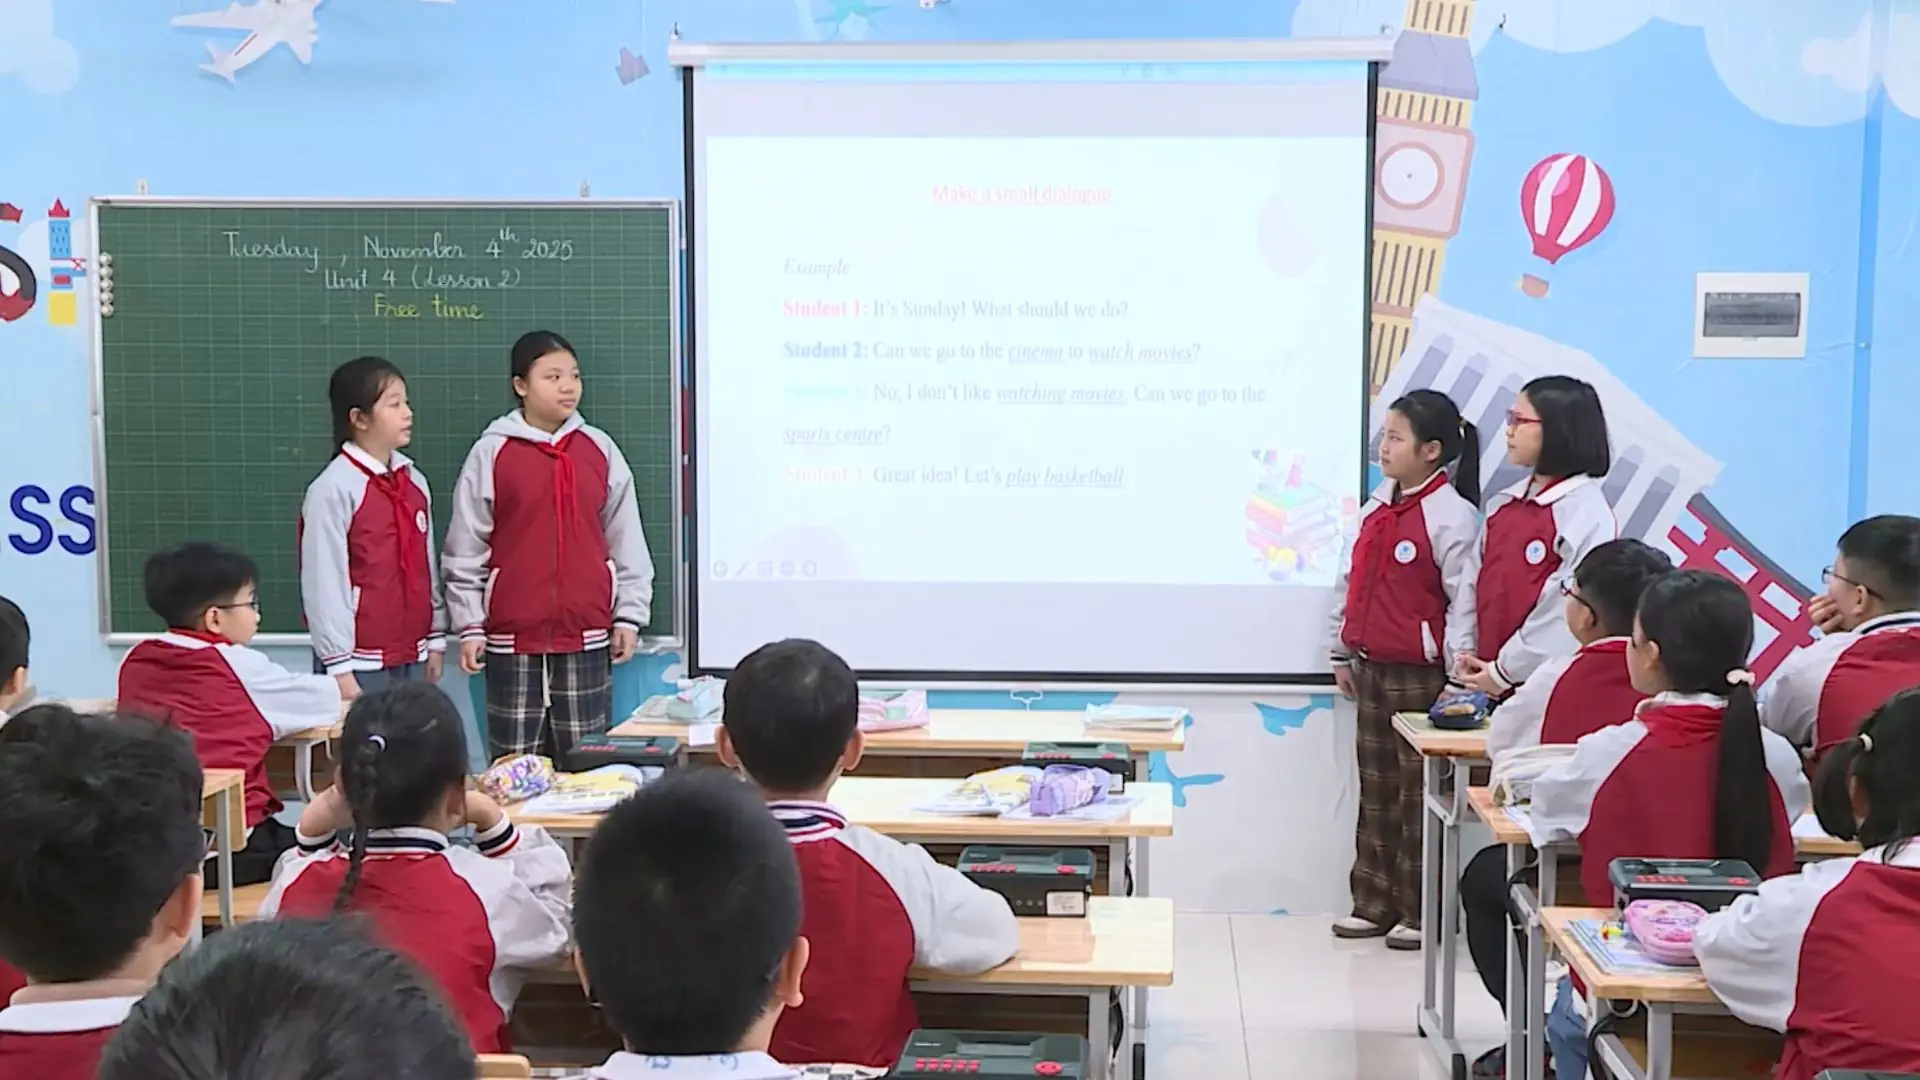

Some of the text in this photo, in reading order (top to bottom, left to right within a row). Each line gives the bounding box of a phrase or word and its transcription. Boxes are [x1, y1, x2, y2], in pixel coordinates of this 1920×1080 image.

[932, 184, 1111, 206] Make a small dialogue
[222, 231, 319, 273] Tuesday
[363, 231, 464, 259] November
[521, 238, 573, 261] 2025
[324, 264, 521, 290] Unit 4 (Lesson 2)
[783, 257, 851, 281] Example
[373, 292, 485, 319] Free time
[783, 299, 1129, 321] Student 1: It's Sunday! What should we do?
[783, 341, 1202, 363] Student 2: Can we go to the cinema to watch movies?
[873, 383, 901, 403] No,
[917, 383, 958, 401] don't
[963, 383, 992, 401] like
[996, 383, 1066, 405] watching
[1133, 384, 1165, 402] Can
[1170, 389, 1193, 402] we
[1197, 389, 1218, 406] go
[1222, 387, 1237, 402] to
[1242, 384, 1266, 402] the
[782, 424, 892, 445] sports centre?
[784, 466, 847, 483] Student
[873, 466, 916, 484] Great
[921, 465, 958, 484] idea!
[964, 465, 1002, 484] Let's
[1006, 466, 1040, 487] play
[1045, 466, 1124, 486] basketball
